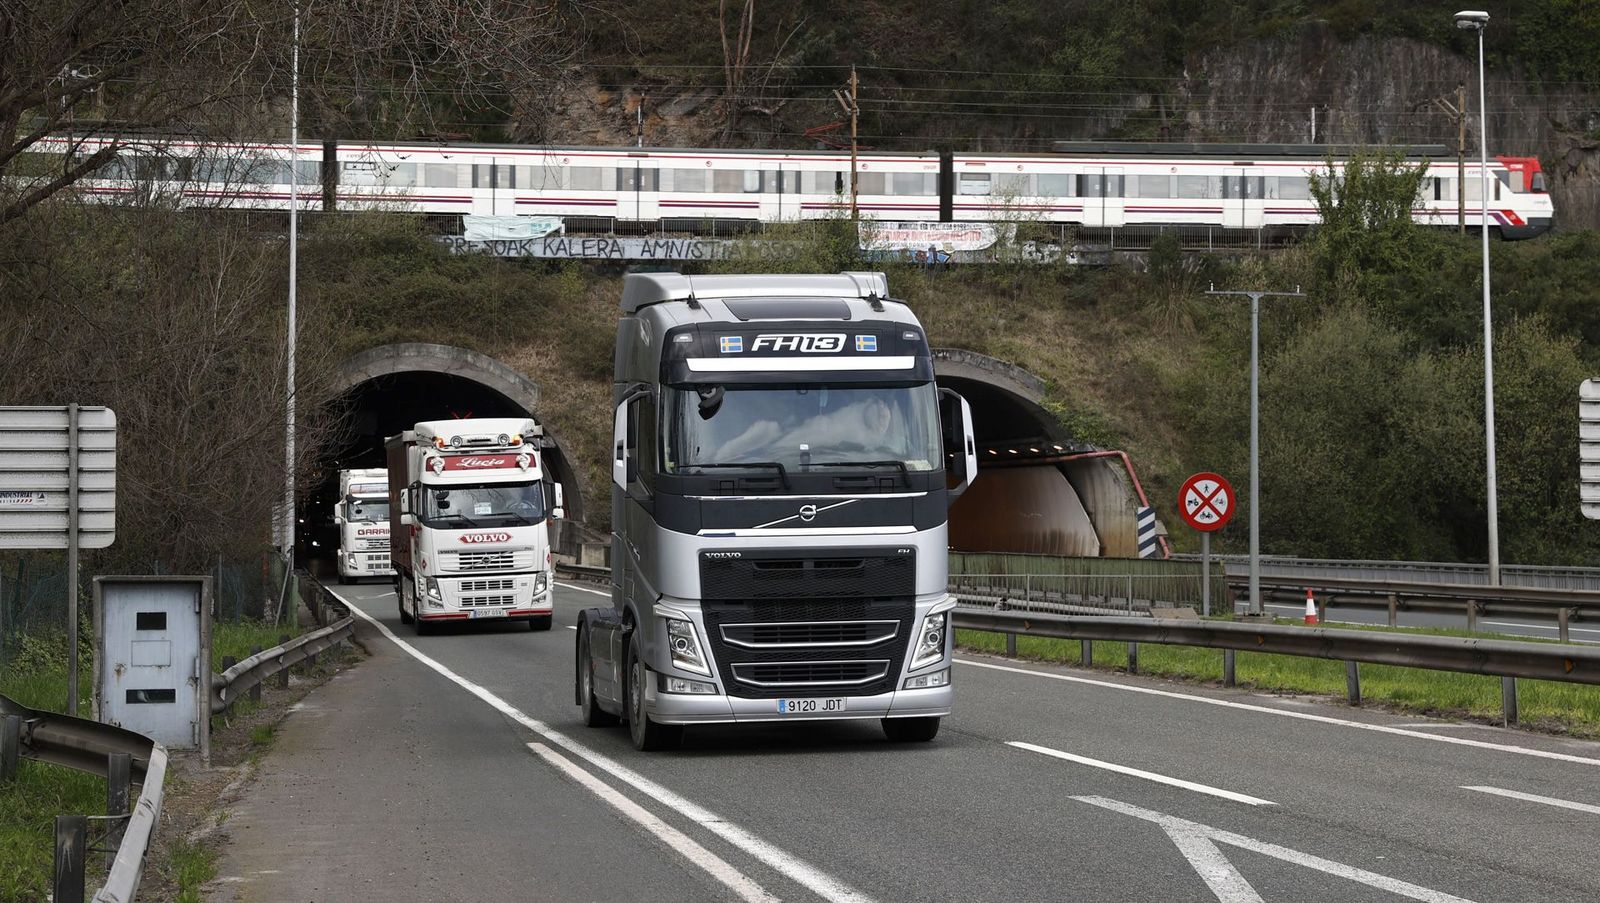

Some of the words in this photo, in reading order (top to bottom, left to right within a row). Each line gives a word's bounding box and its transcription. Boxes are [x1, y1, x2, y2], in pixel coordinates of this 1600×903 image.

[543, 237, 624, 259] KALERA
[751, 333, 847, 353] FH13
[456, 456, 505, 468] Lucia
[464, 532, 508, 543] VOLVO
[788, 700, 816, 712] 9120
[822, 699, 842, 711] JDT
